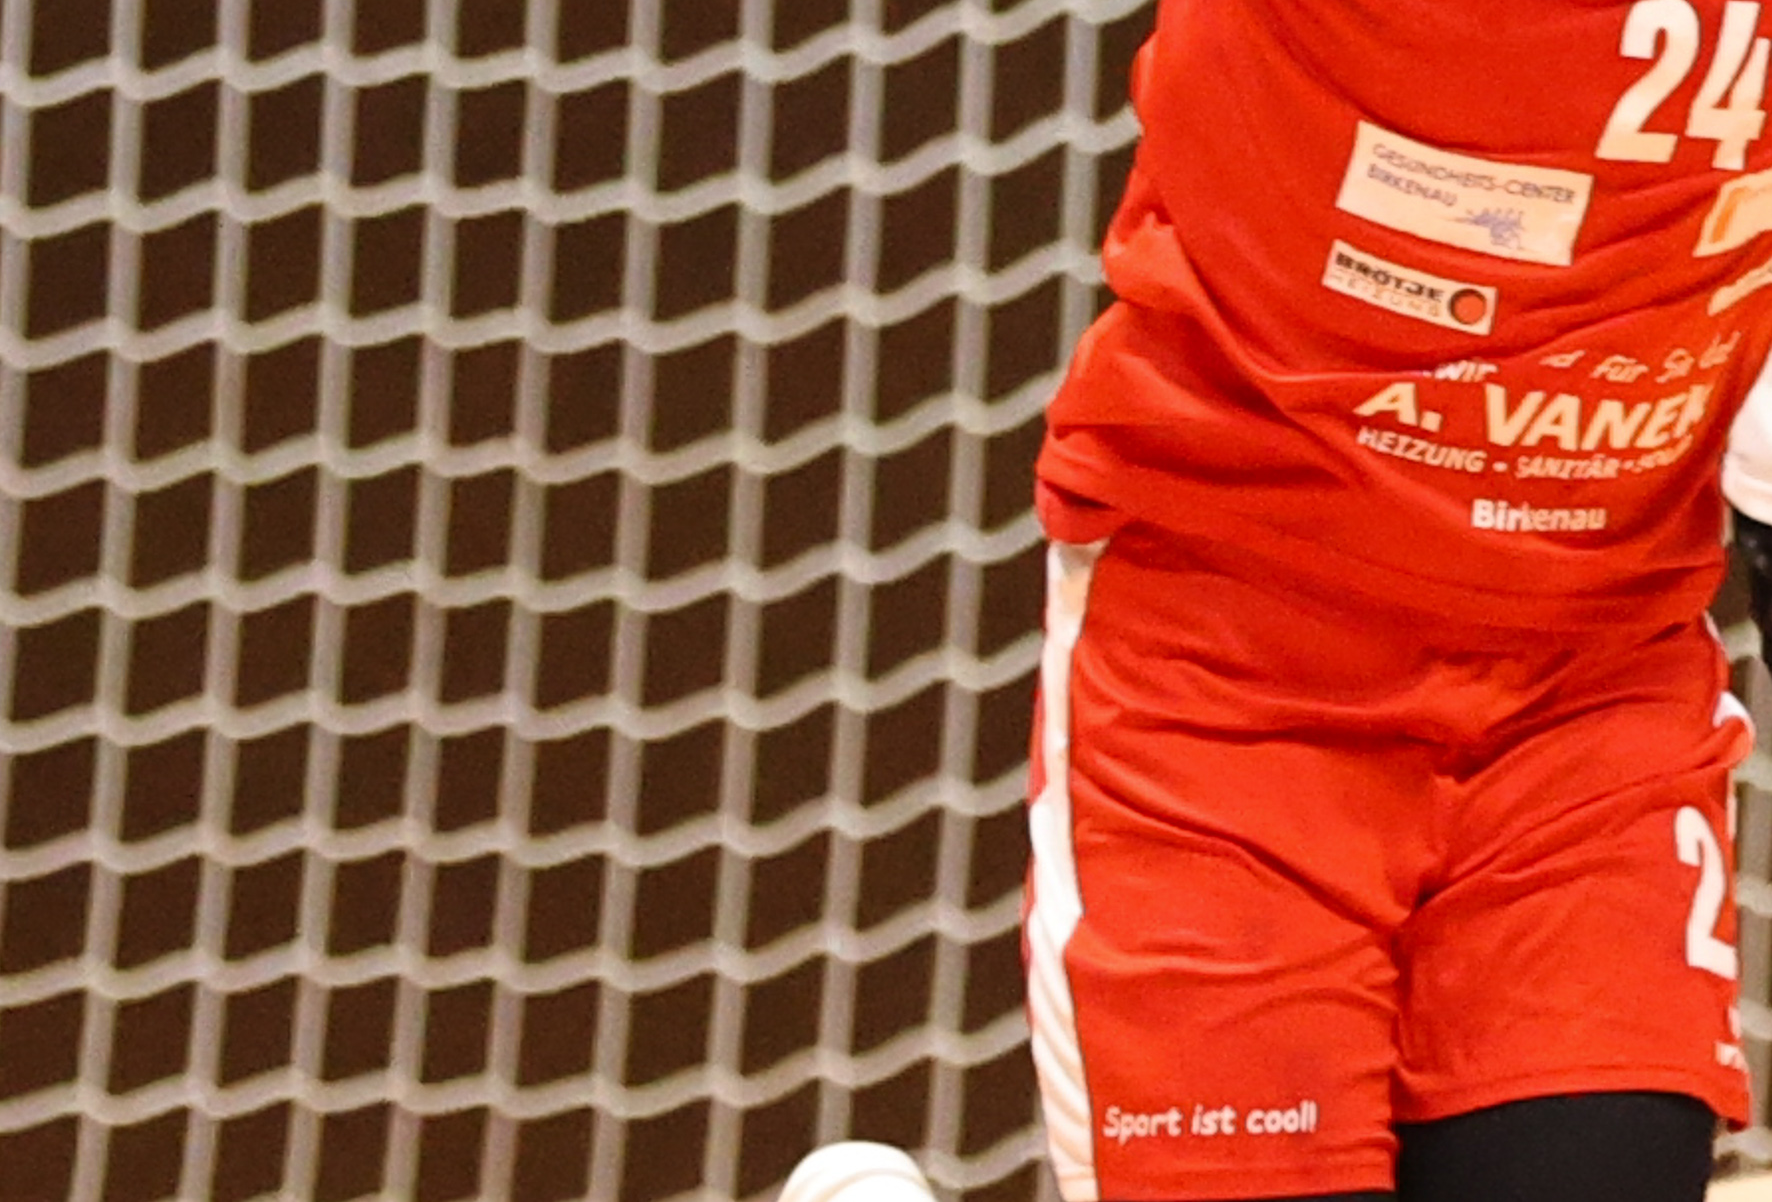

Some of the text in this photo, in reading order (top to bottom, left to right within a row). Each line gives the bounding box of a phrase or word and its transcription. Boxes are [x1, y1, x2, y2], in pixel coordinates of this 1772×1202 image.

[1353, 382, 1443, 432] A.
[1356, 425, 1488, 474] HEIZUNG
[1471, 499, 1606, 532] Birkenau
[1674, 806, 1739, 980] 2
[1102, 1105, 1182, 1146] Sport
[1191, 1103, 1237, 1136] ist
